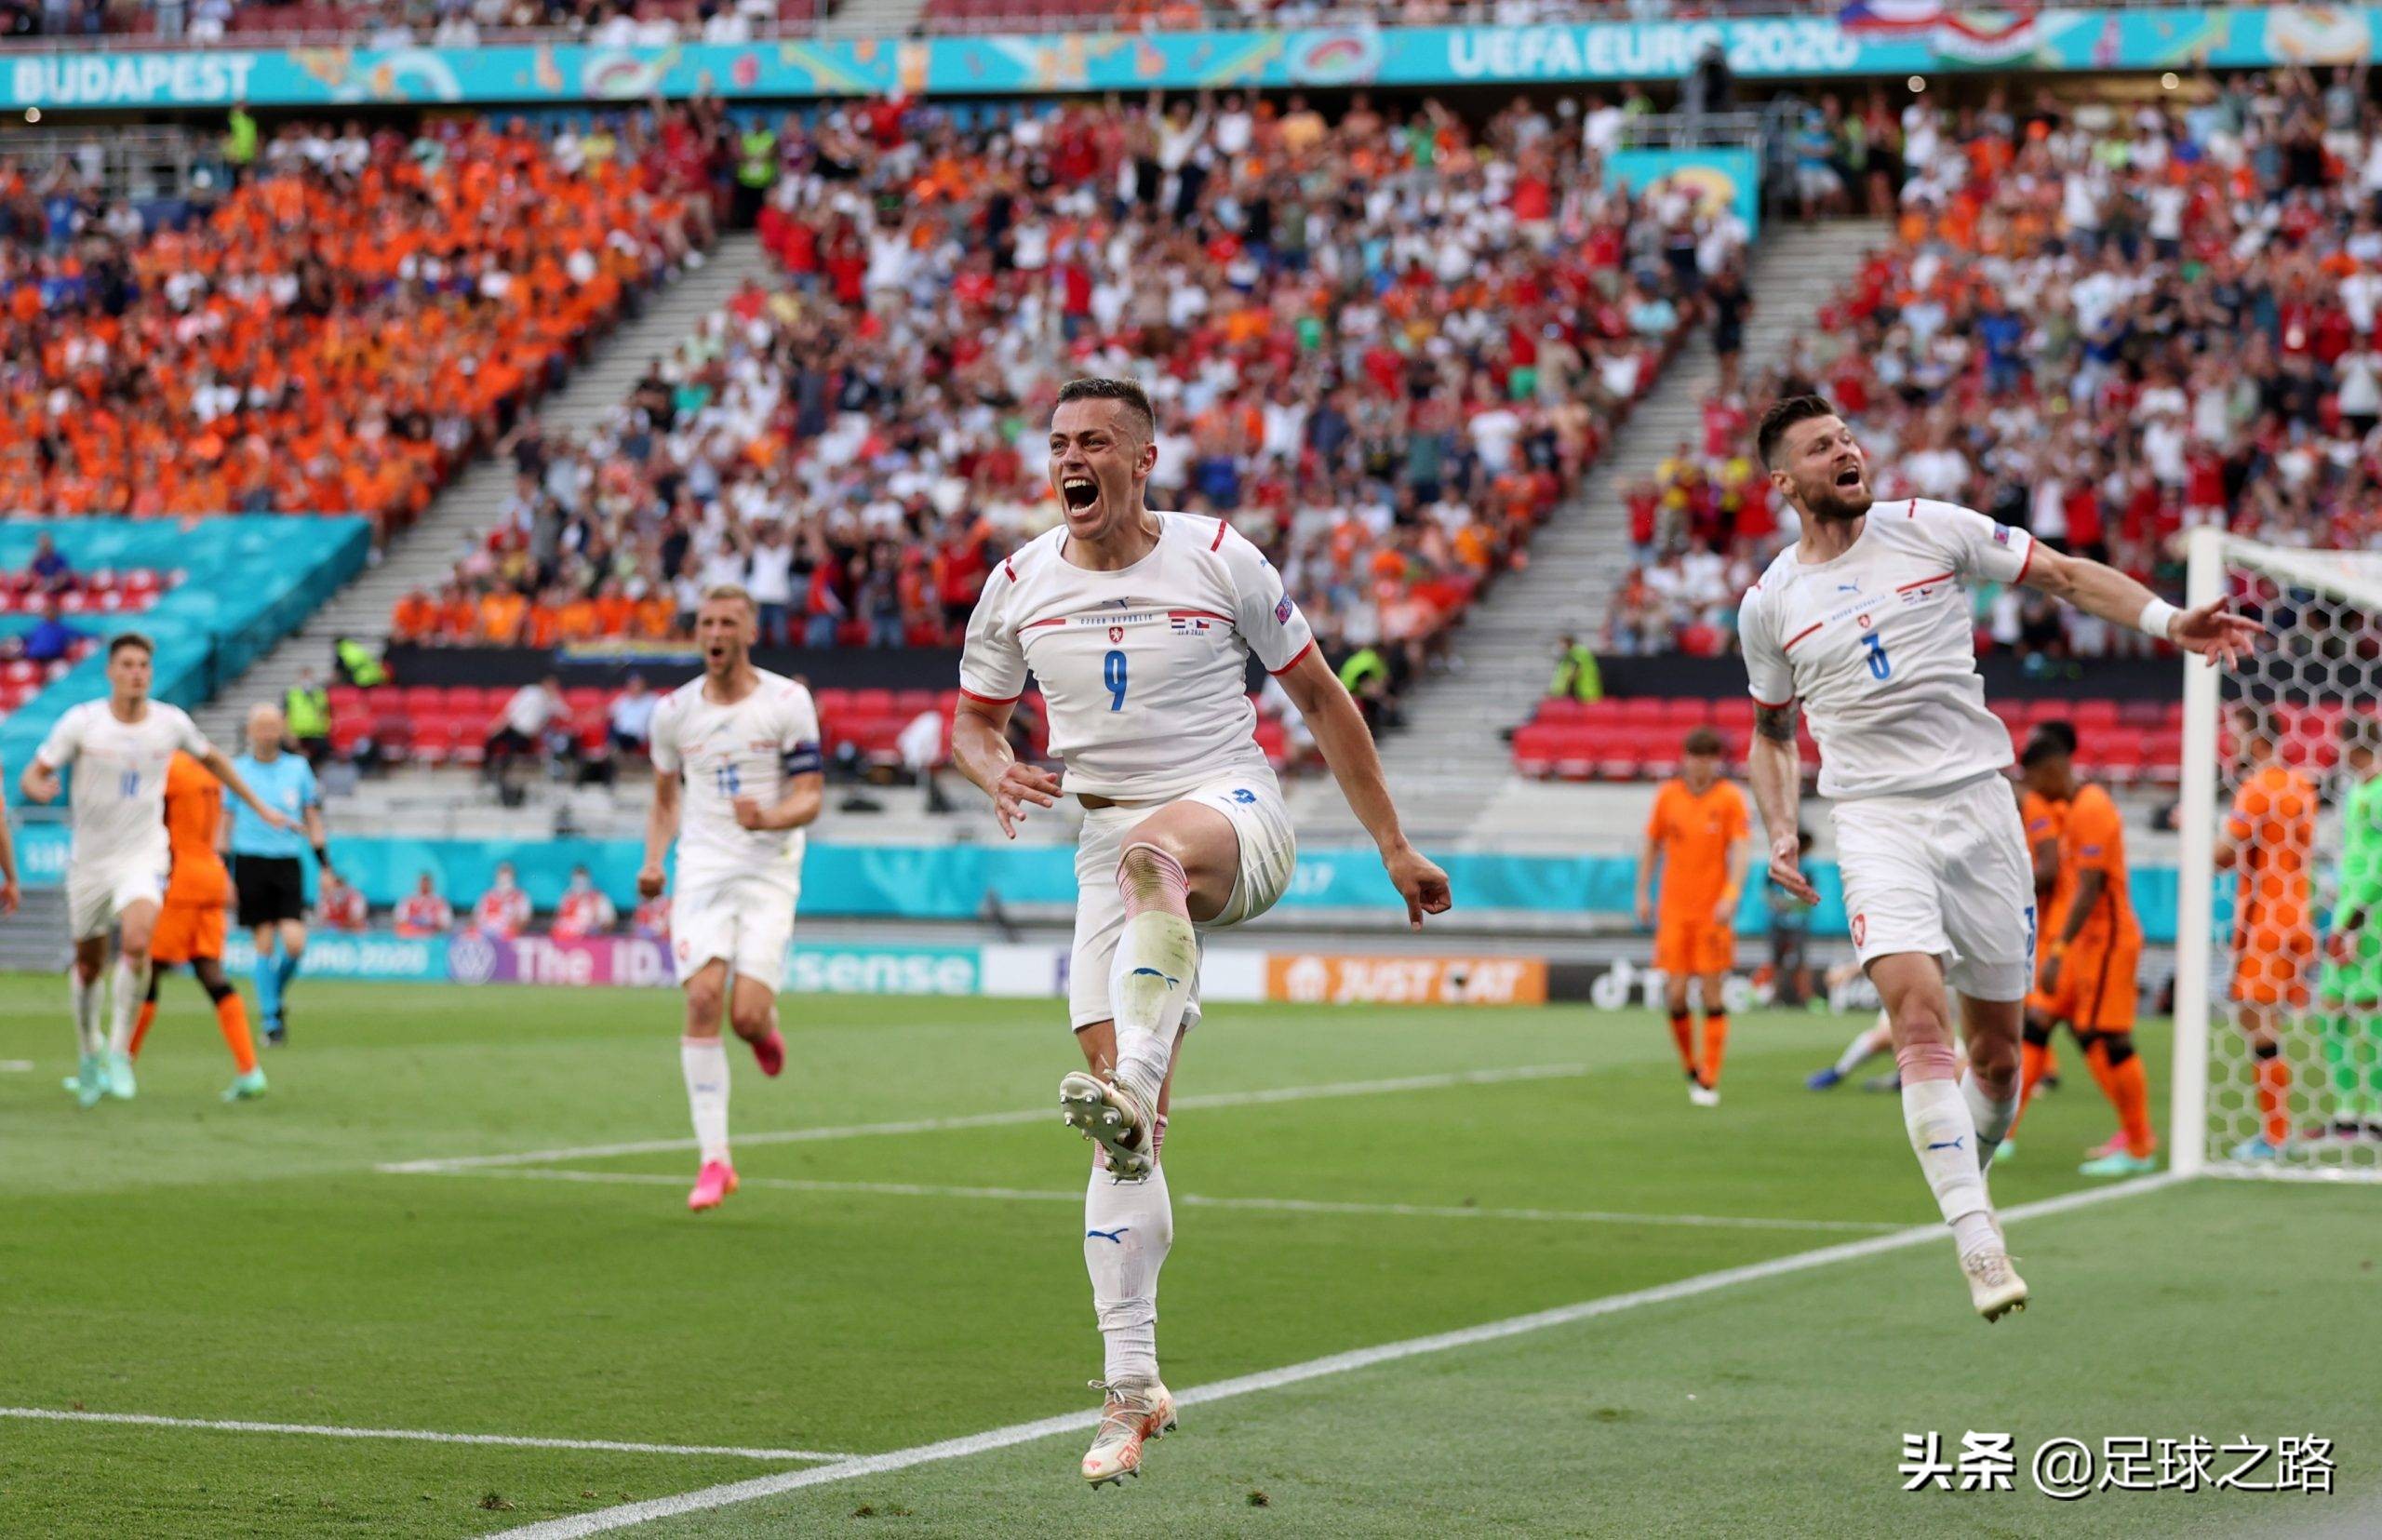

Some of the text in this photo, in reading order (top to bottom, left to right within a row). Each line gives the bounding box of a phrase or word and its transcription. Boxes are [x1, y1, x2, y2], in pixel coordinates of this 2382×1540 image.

[1449, 26, 1579, 76] UEFA
[1729, 17, 1859, 73] 2020
[13, 54, 257, 104] BUDAPEST
[1104, 650, 1128, 712] 9
[515, 937, 594, 985] The
[1333, 959, 1436, 1004] JUST
